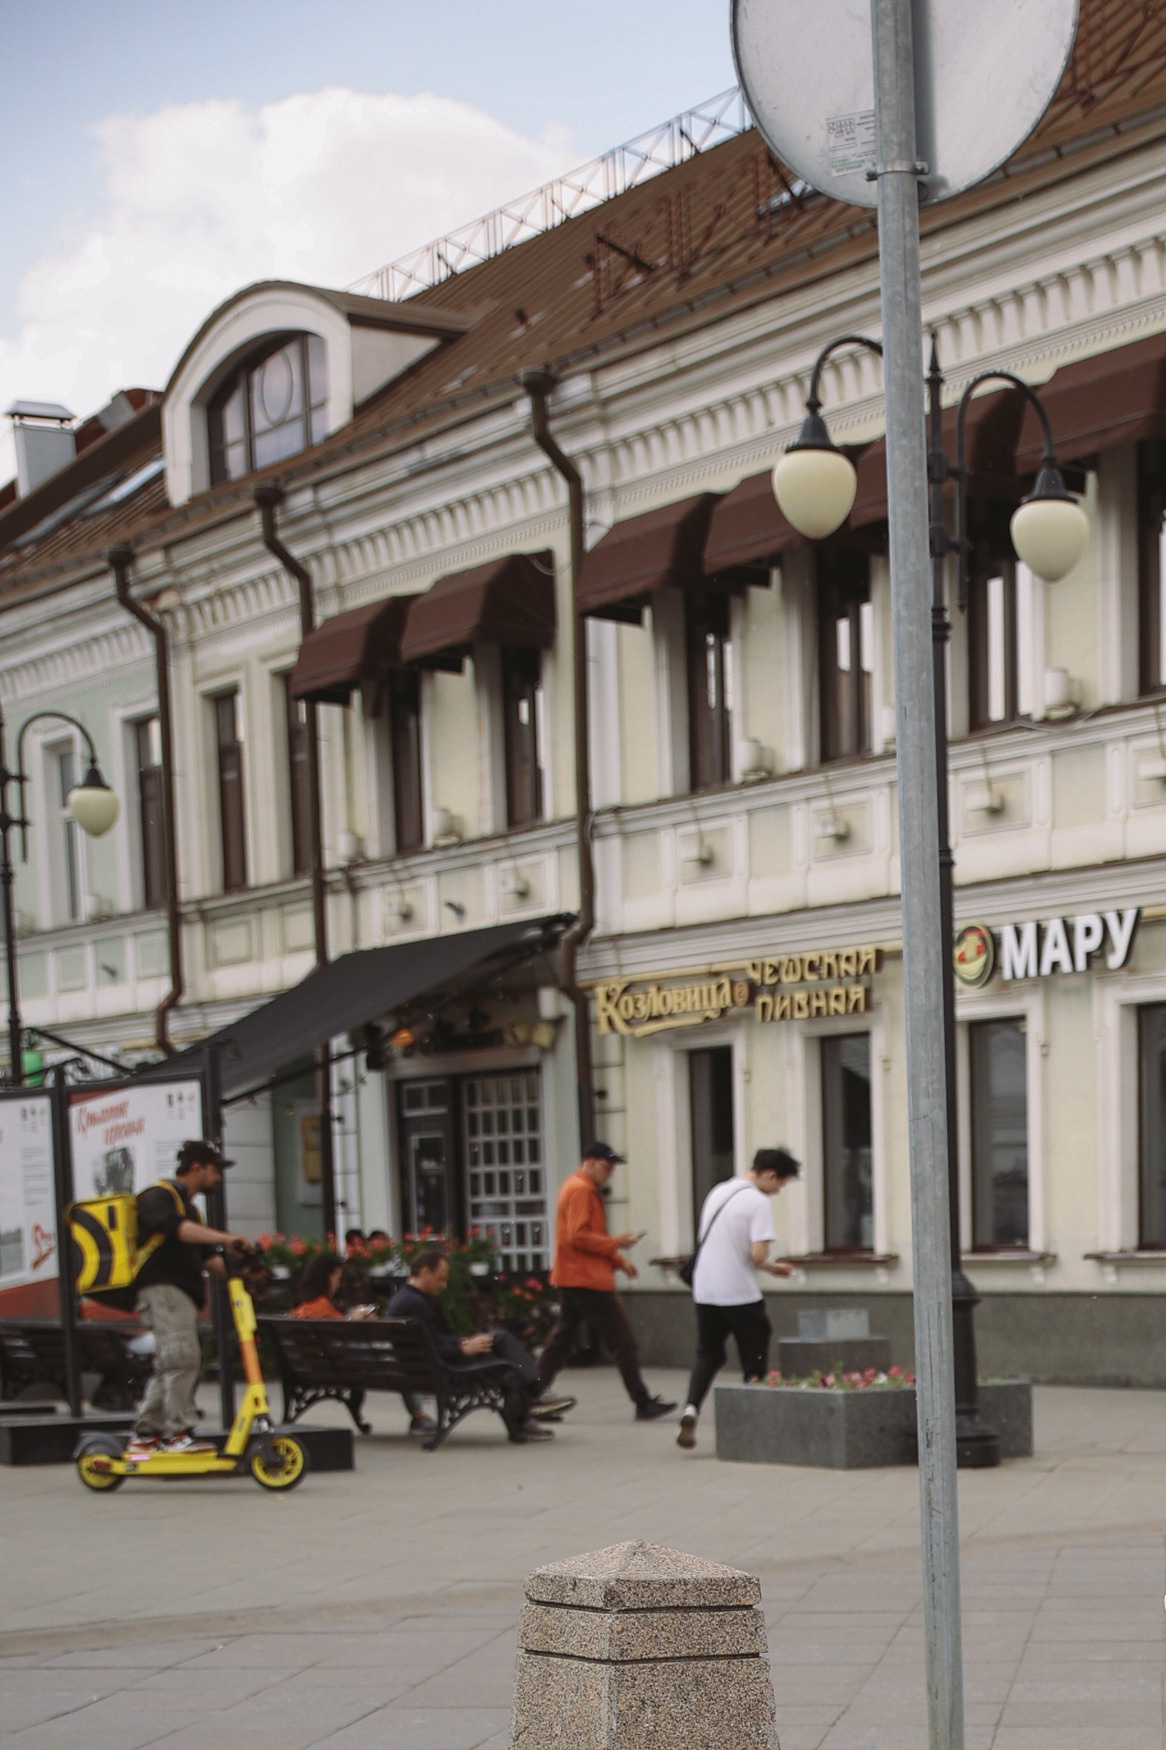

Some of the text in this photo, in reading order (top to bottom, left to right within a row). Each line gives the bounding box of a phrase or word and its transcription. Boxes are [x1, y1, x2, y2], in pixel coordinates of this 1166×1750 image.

[746, 947, 879, 986] ЧЕШСКАЯ
[1001, 907, 1139, 981] МАРУ
[594, 975, 734, 1037] Козловица
[755, 983, 867, 1023] ПИВНАЯ
